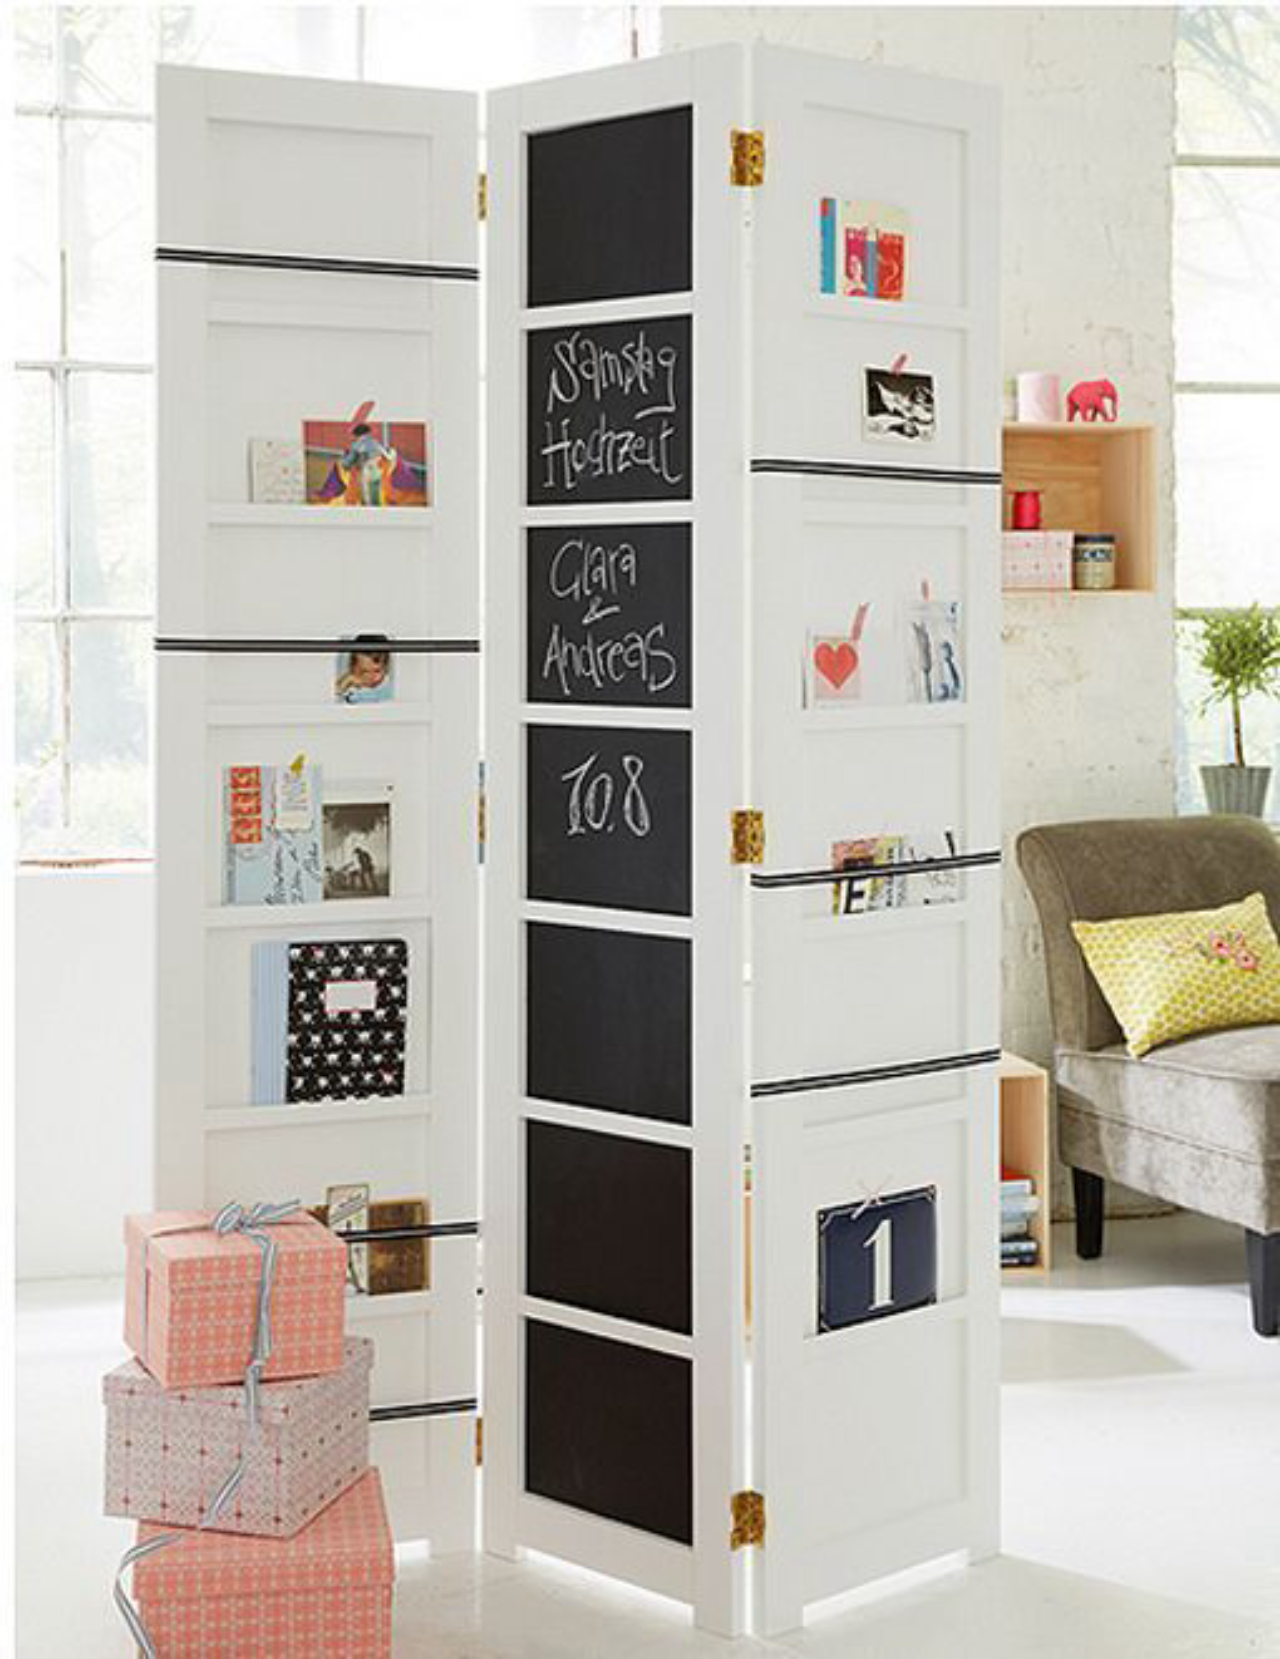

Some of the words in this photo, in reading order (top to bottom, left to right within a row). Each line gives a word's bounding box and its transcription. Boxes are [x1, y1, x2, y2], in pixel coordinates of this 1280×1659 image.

[546, 330, 678, 420] Samstag
[541, 412, 683, 490] Hochzeit
[862, 1218, 896, 1312] 1
